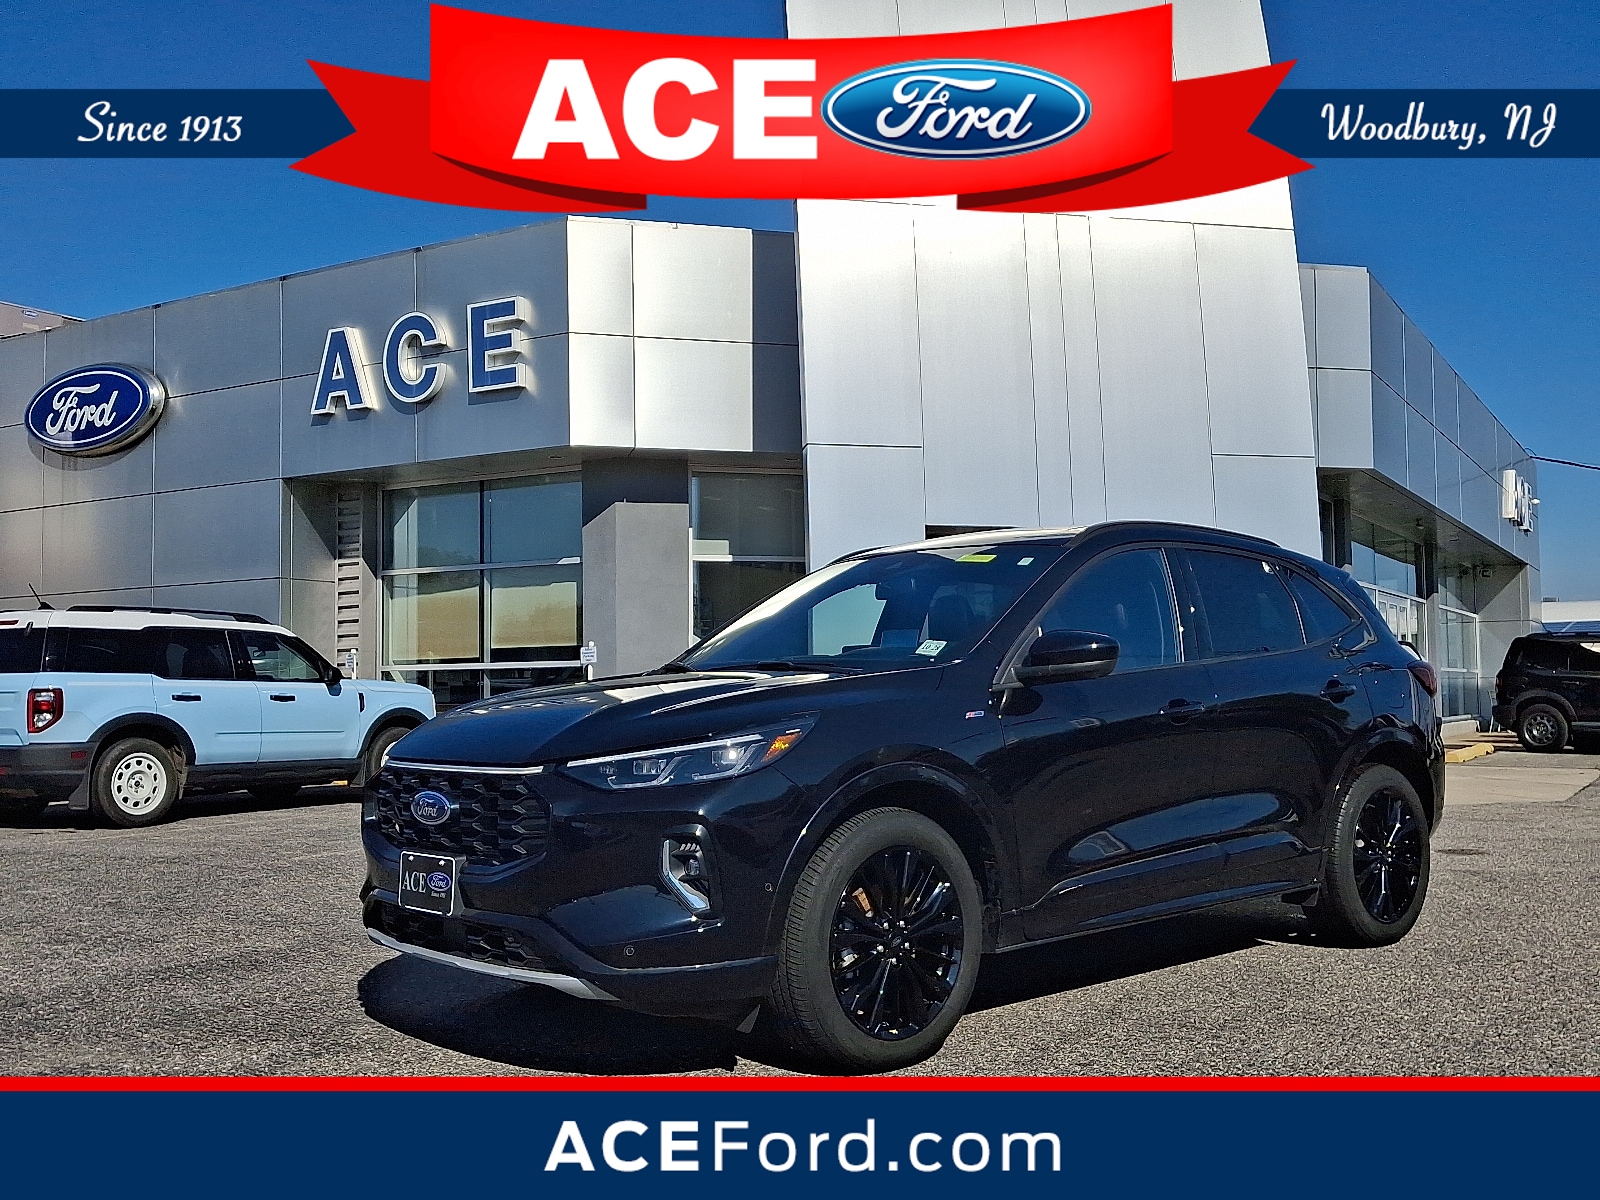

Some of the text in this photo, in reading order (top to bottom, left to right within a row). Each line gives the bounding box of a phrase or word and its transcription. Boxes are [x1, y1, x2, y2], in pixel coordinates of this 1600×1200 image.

[310, 295, 528, 416] ACE
[46, 384, 118, 436] Ford
[402, 870, 427, 893] ACE
